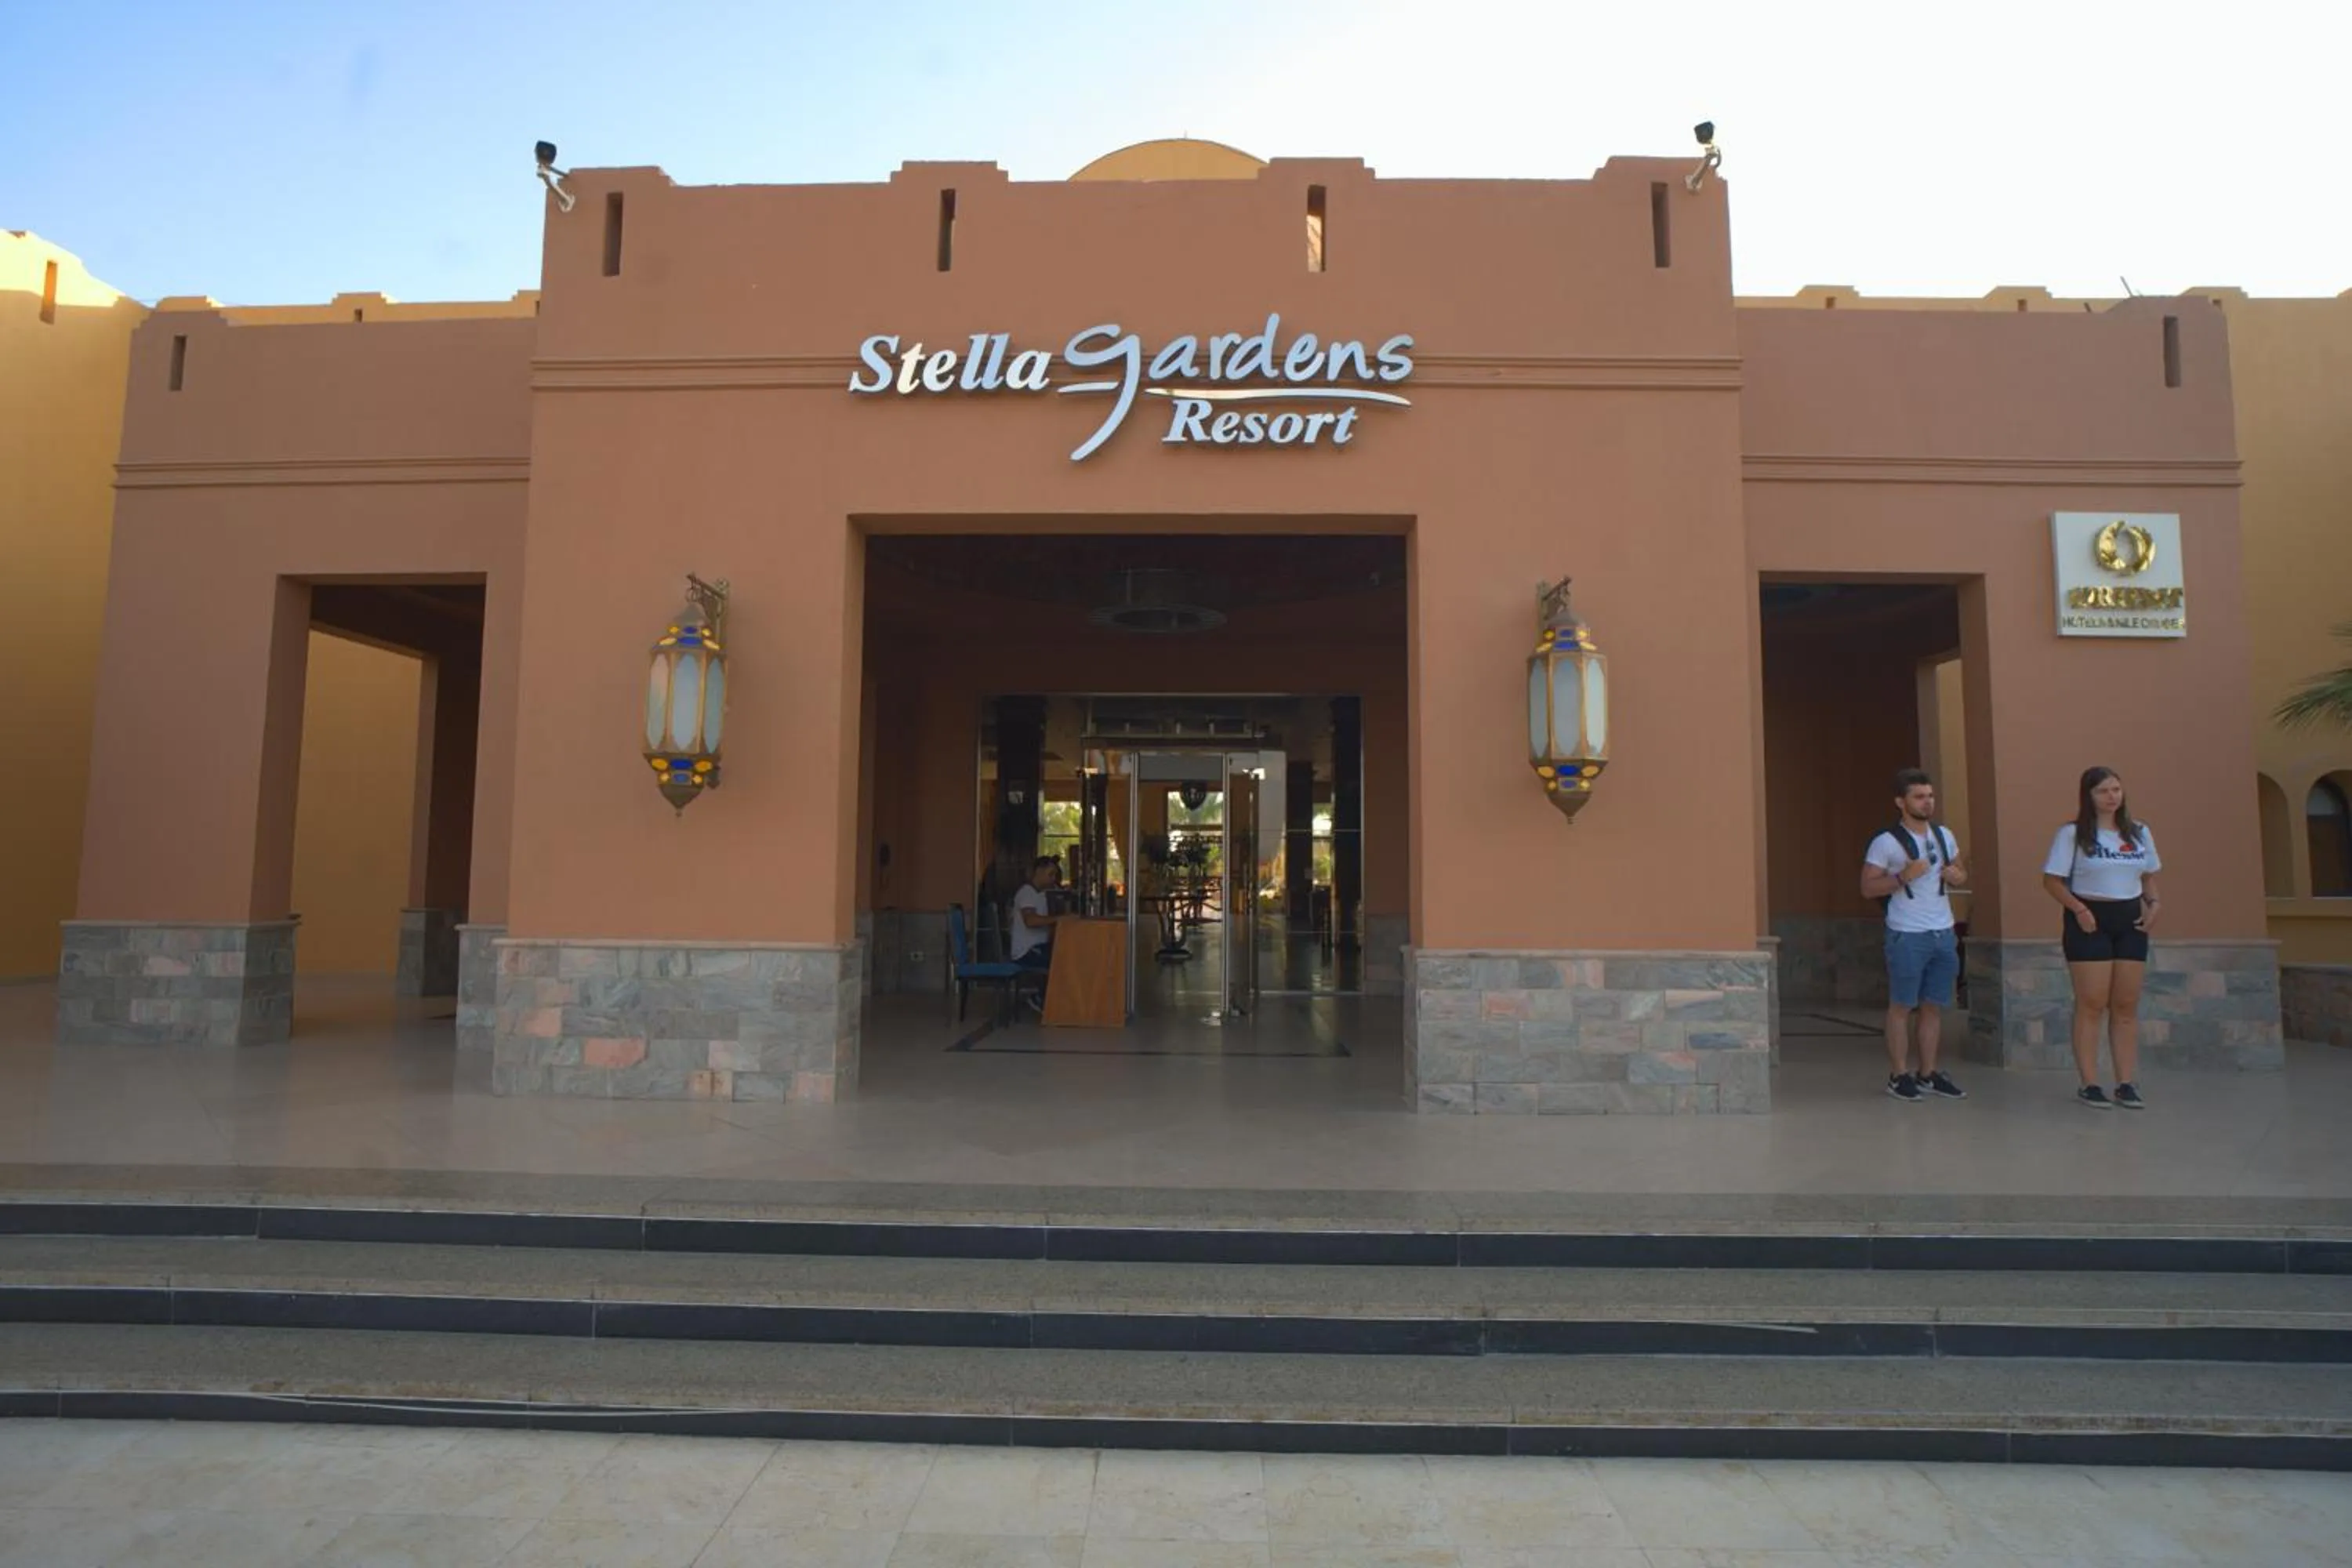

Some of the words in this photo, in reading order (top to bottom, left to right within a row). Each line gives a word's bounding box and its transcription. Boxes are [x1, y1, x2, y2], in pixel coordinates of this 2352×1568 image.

[848, 332, 1052, 394] Stella
[1058, 313, 1414, 461] gardens
[1161, 398, 1359, 444] Resort
